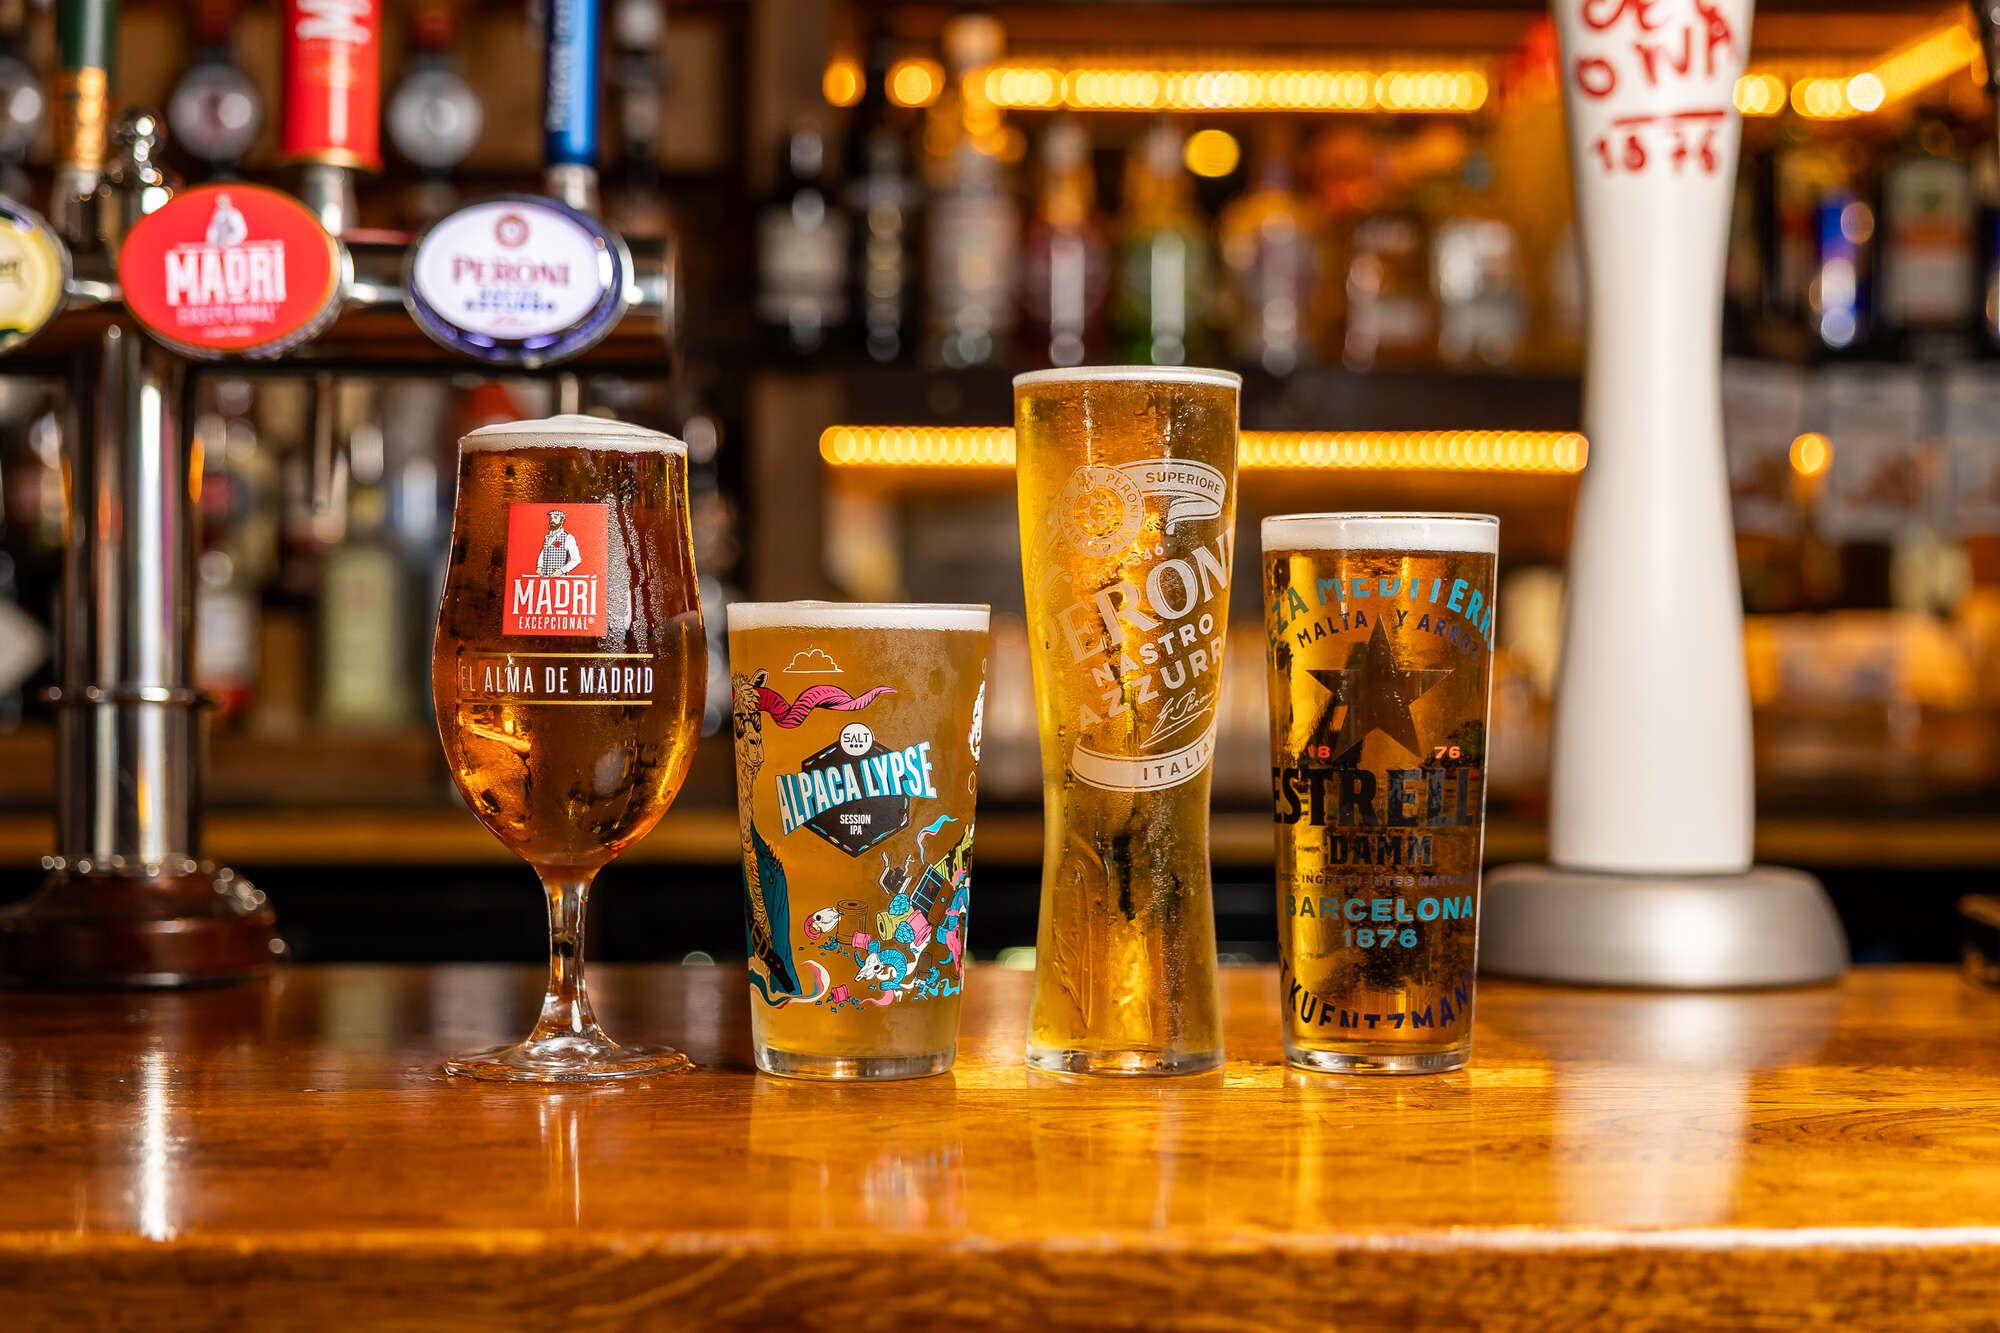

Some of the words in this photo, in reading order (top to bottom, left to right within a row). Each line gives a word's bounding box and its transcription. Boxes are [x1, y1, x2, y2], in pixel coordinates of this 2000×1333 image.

[453, 254, 571, 287] PERONI
[1105, 472, 1140, 519] PERONI
[1145, 471, 1221, 495] SUPERIORE
[512, 574, 597, 616] MADRÍ
[1297, 609, 1368, 649] MALTA
[1395, 608, 1410, 629] Y
[1090, 612, 1215, 688] NASTRO
[460, 665, 477, 693] EL
[484, 665, 535, 694] ALMA
[545, 666, 569, 694] DE
[580, 666, 654, 695] MADRID
[843, 732, 870, 744] SALT
[1434, 745, 1462, 760] 76
[1143, 733, 1214, 781] ITALIA
[775, 762, 863, 836] ALPACA
[839, 813, 872, 825] SESSION
[850, 825, 863, 836] IPA
[1328, 833, 1433, 866] DAMM
[1284, 895, 1474, 922] BARCELONA
[1343, 928, 1418, 949] 1876
